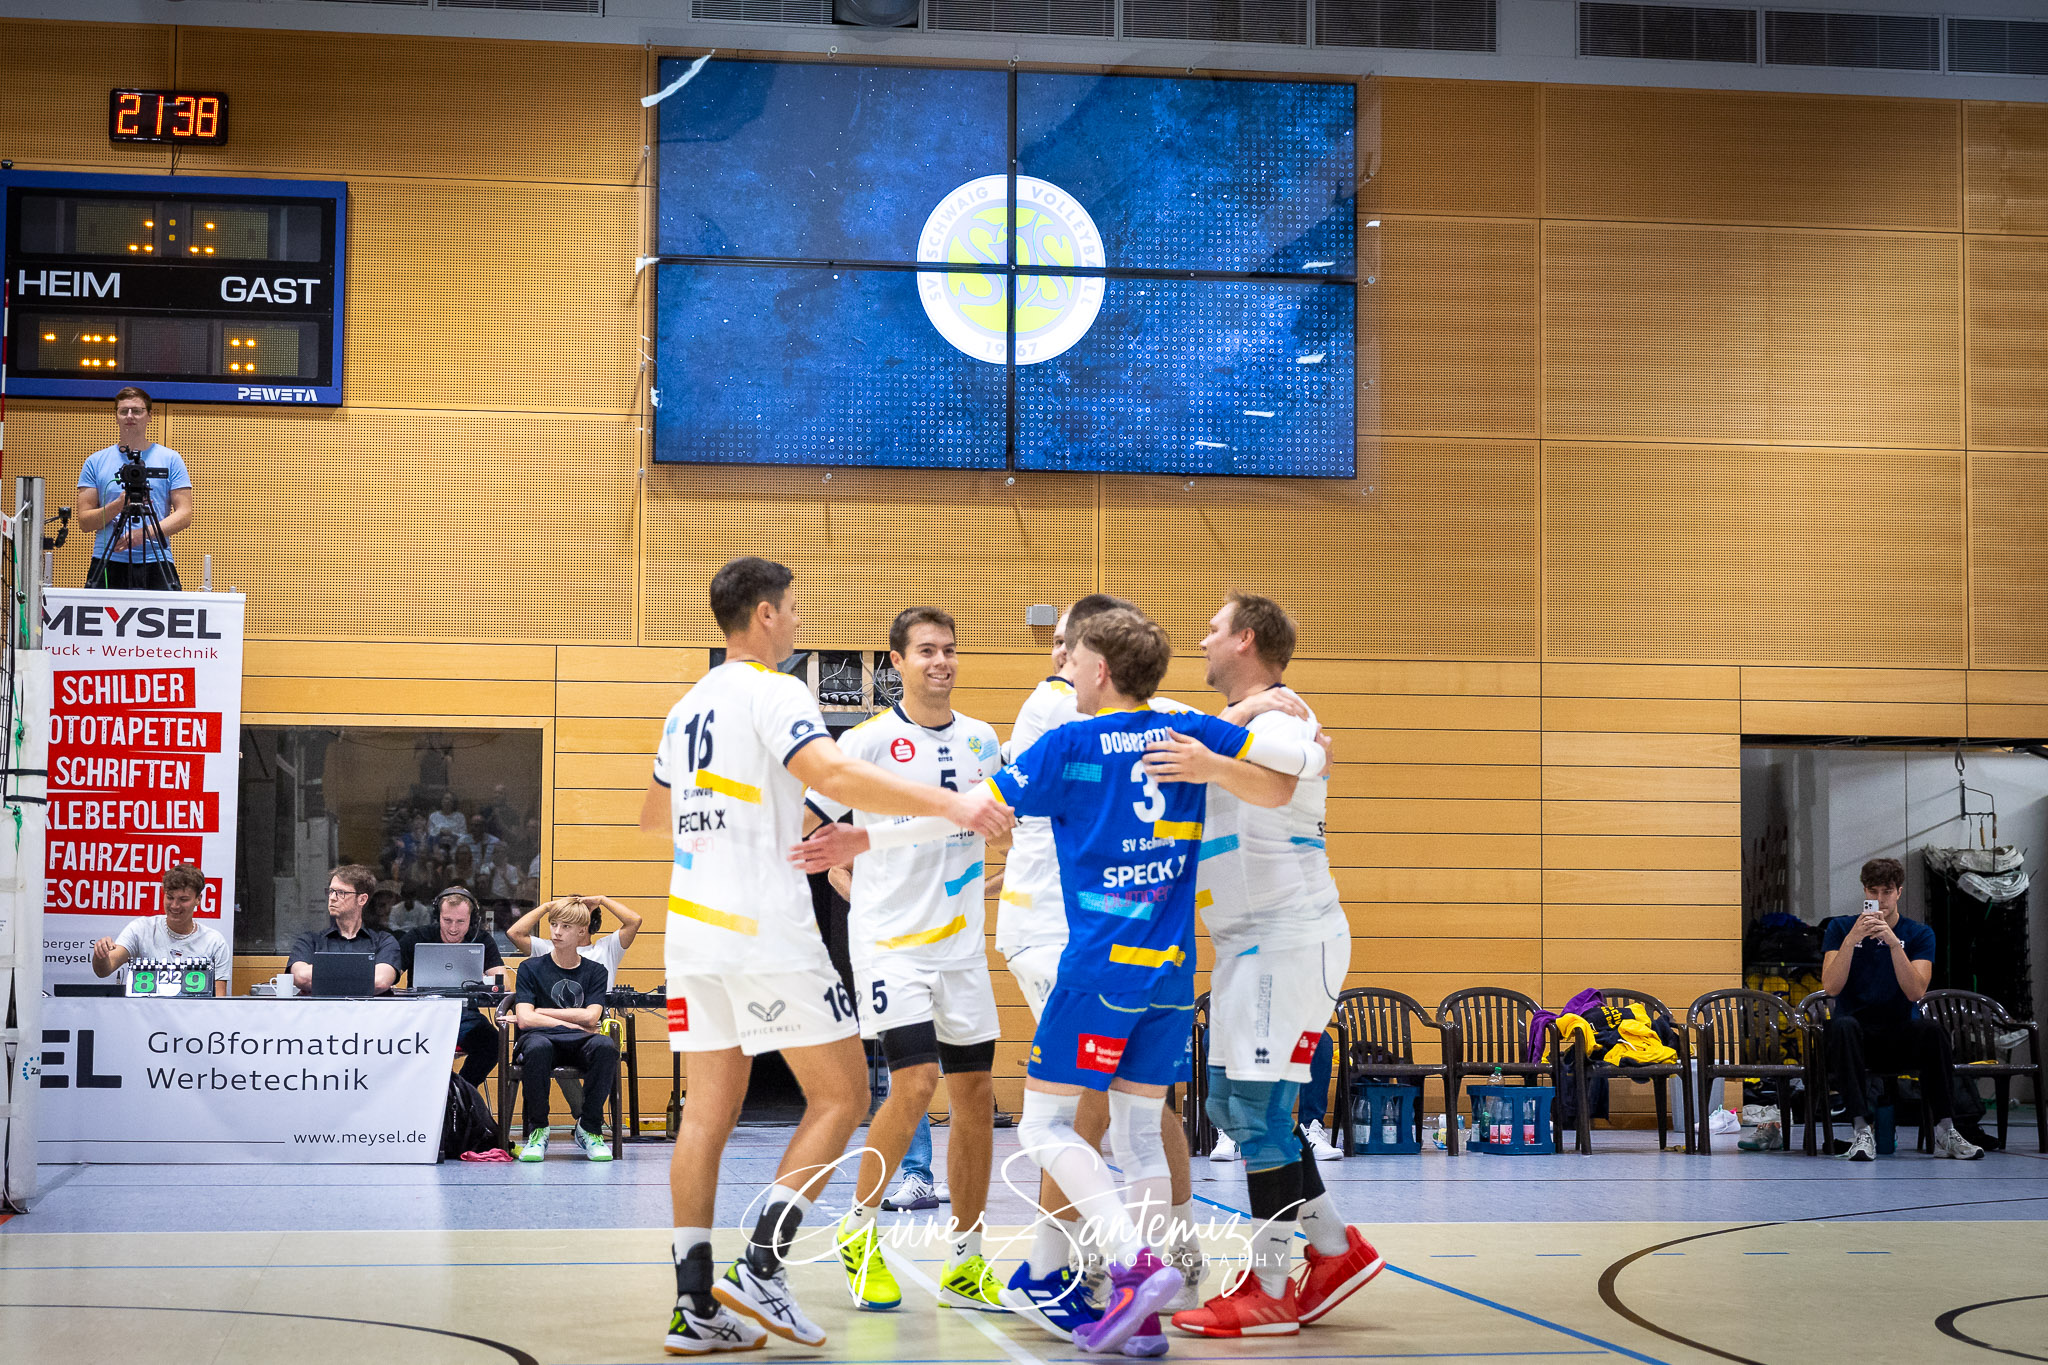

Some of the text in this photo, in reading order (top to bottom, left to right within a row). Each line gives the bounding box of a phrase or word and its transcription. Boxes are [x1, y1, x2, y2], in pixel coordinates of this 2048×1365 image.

[926, 185, 989, 259] SCHWAIG
[17, 269, 321, 304] HEIM GAST
[237, 387, 318, 402] PEWETA
[102, 644, 219, 660] Werbetechnik
[61, 673, 185, 705] SCHILDER
[684, 709, 715, 773] 16
[55, 756, 190, 790] SCHRIFTEN
[1130, 759, 1166, 824] 3
[1122, 838, 1137, 853] SV
[1102, 861, 1174, 889] SPECK
[133, 970, 155, 993] 8
[184, 970, 207, 993] 9
[823, 981, 855, 1022] 16
[872, 979, 888, 1015] 5
[147, 1030, 430, 1056] Großformatdruck
[147, 1066, 369, 1091] Werbetechnik
[293, 1130, 427, 1147] www.meysel.de
